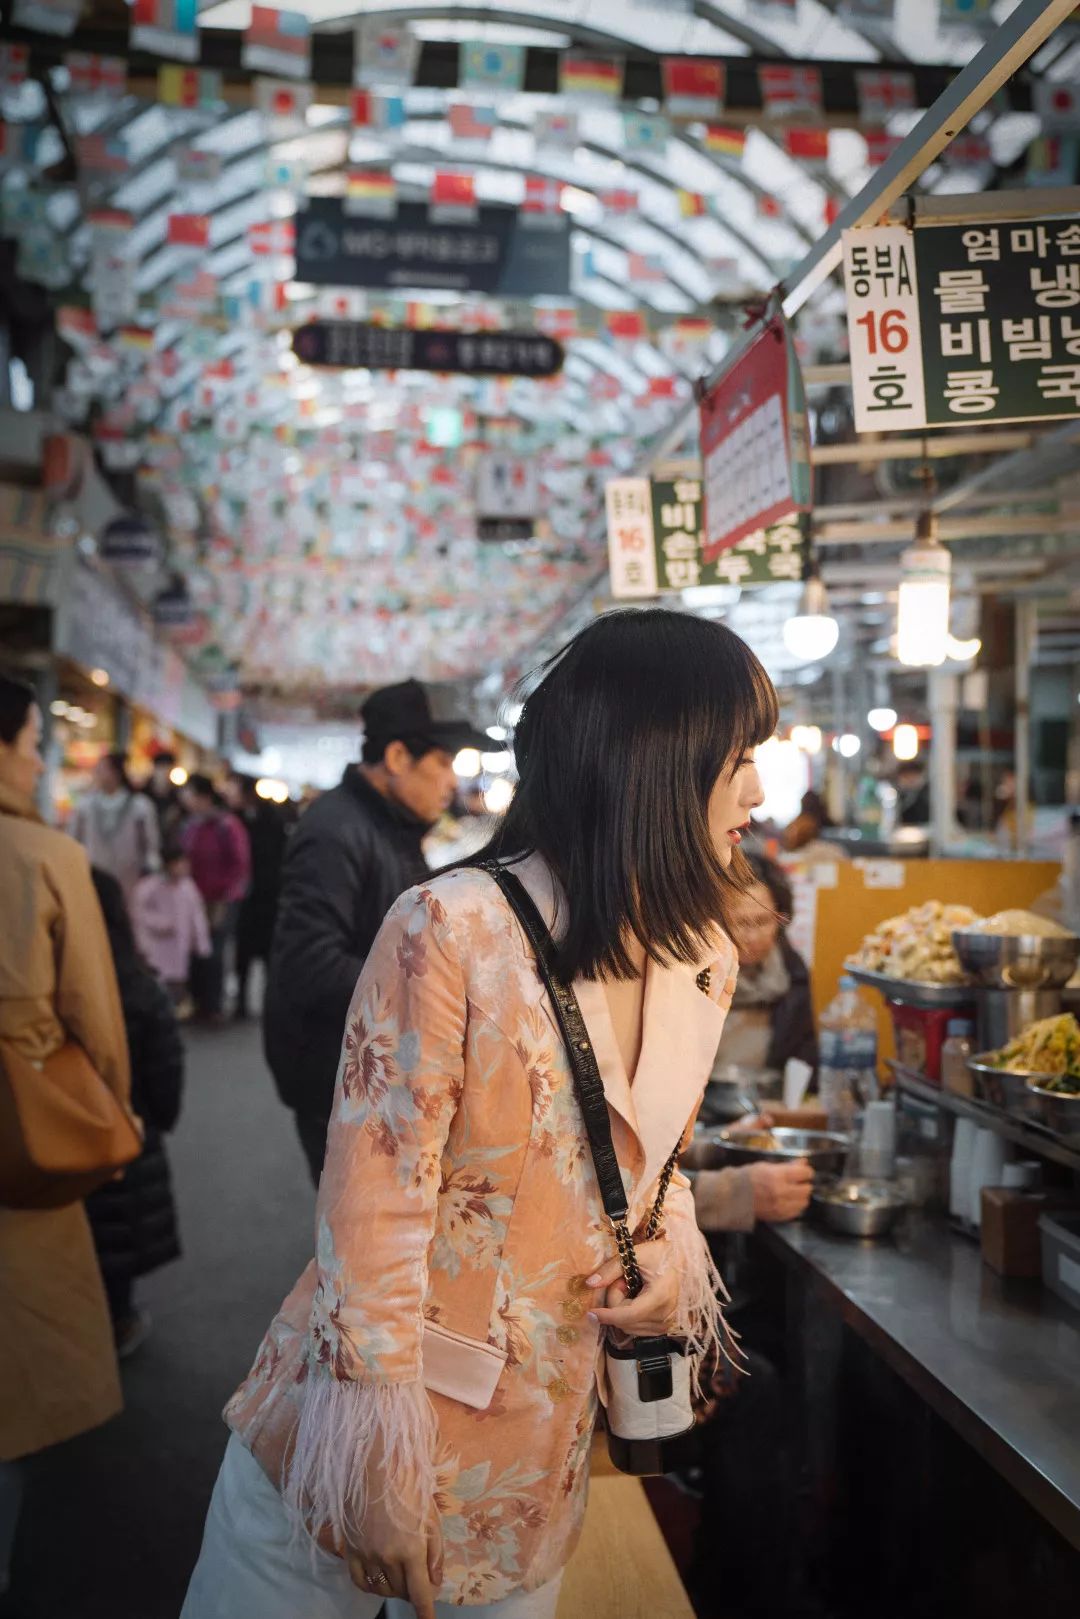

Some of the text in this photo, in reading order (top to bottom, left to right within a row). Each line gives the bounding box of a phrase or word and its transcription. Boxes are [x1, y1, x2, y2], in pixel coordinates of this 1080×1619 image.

[852, 245, 912, 297] 동부A
[857, 310, 908, 354] 16
[867, 366, 912, 412] 호
